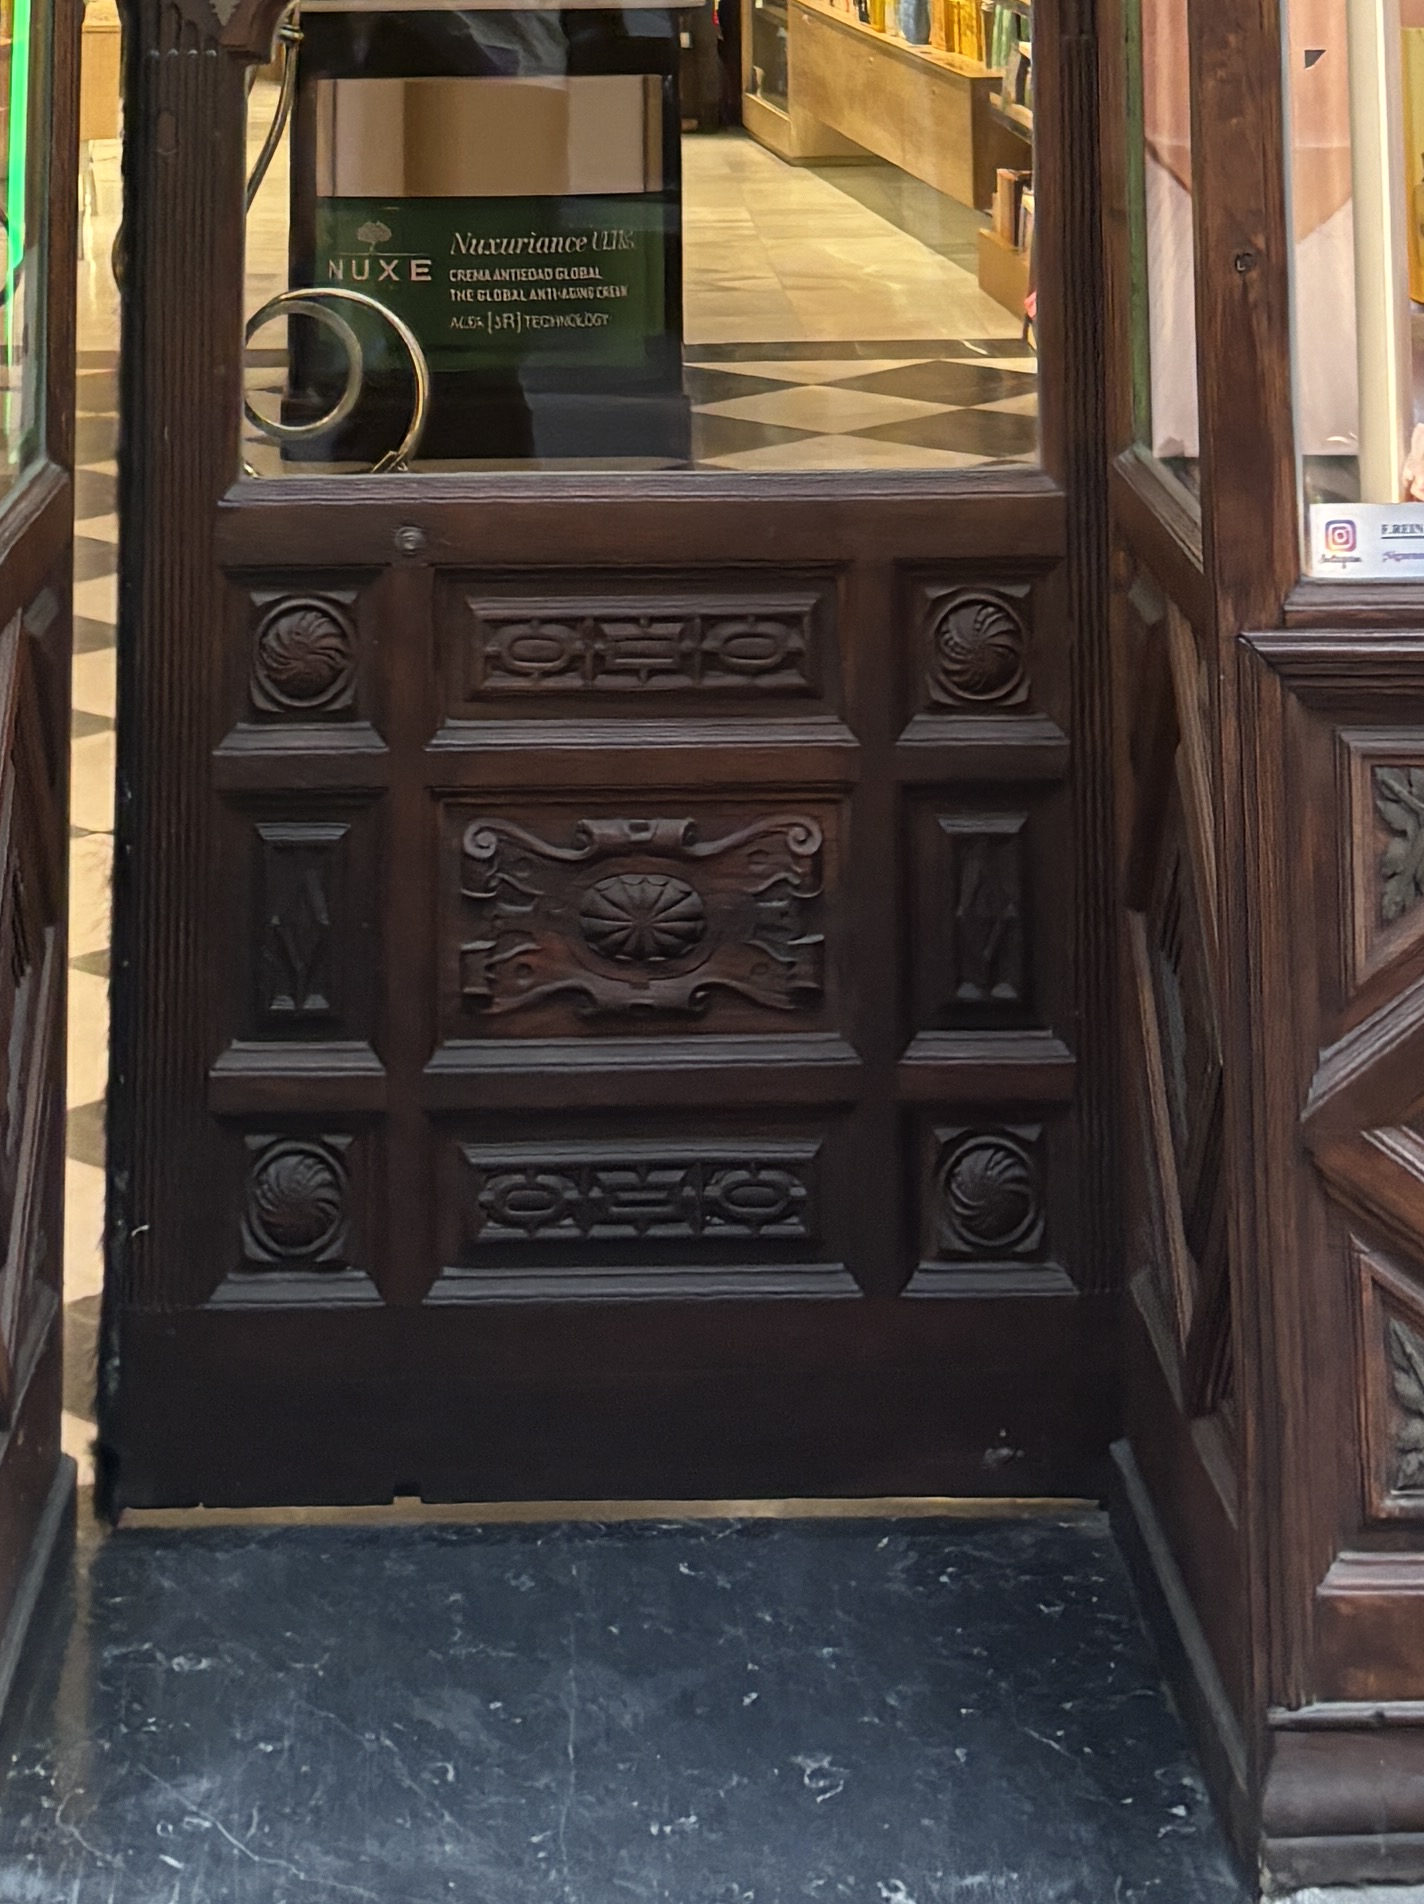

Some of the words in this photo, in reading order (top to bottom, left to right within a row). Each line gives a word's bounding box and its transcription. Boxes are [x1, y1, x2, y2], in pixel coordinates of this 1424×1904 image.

[328, 258, 433, 282] NUXE
[449, 267, 493, 283] CREMA
[493, 267, 554, 282] ANTIEDAD
[555, 266, 604, 281] GLOBAL
[449, 288, 475, 303] THE
[477, 288, 528, 303] GLOBAL
